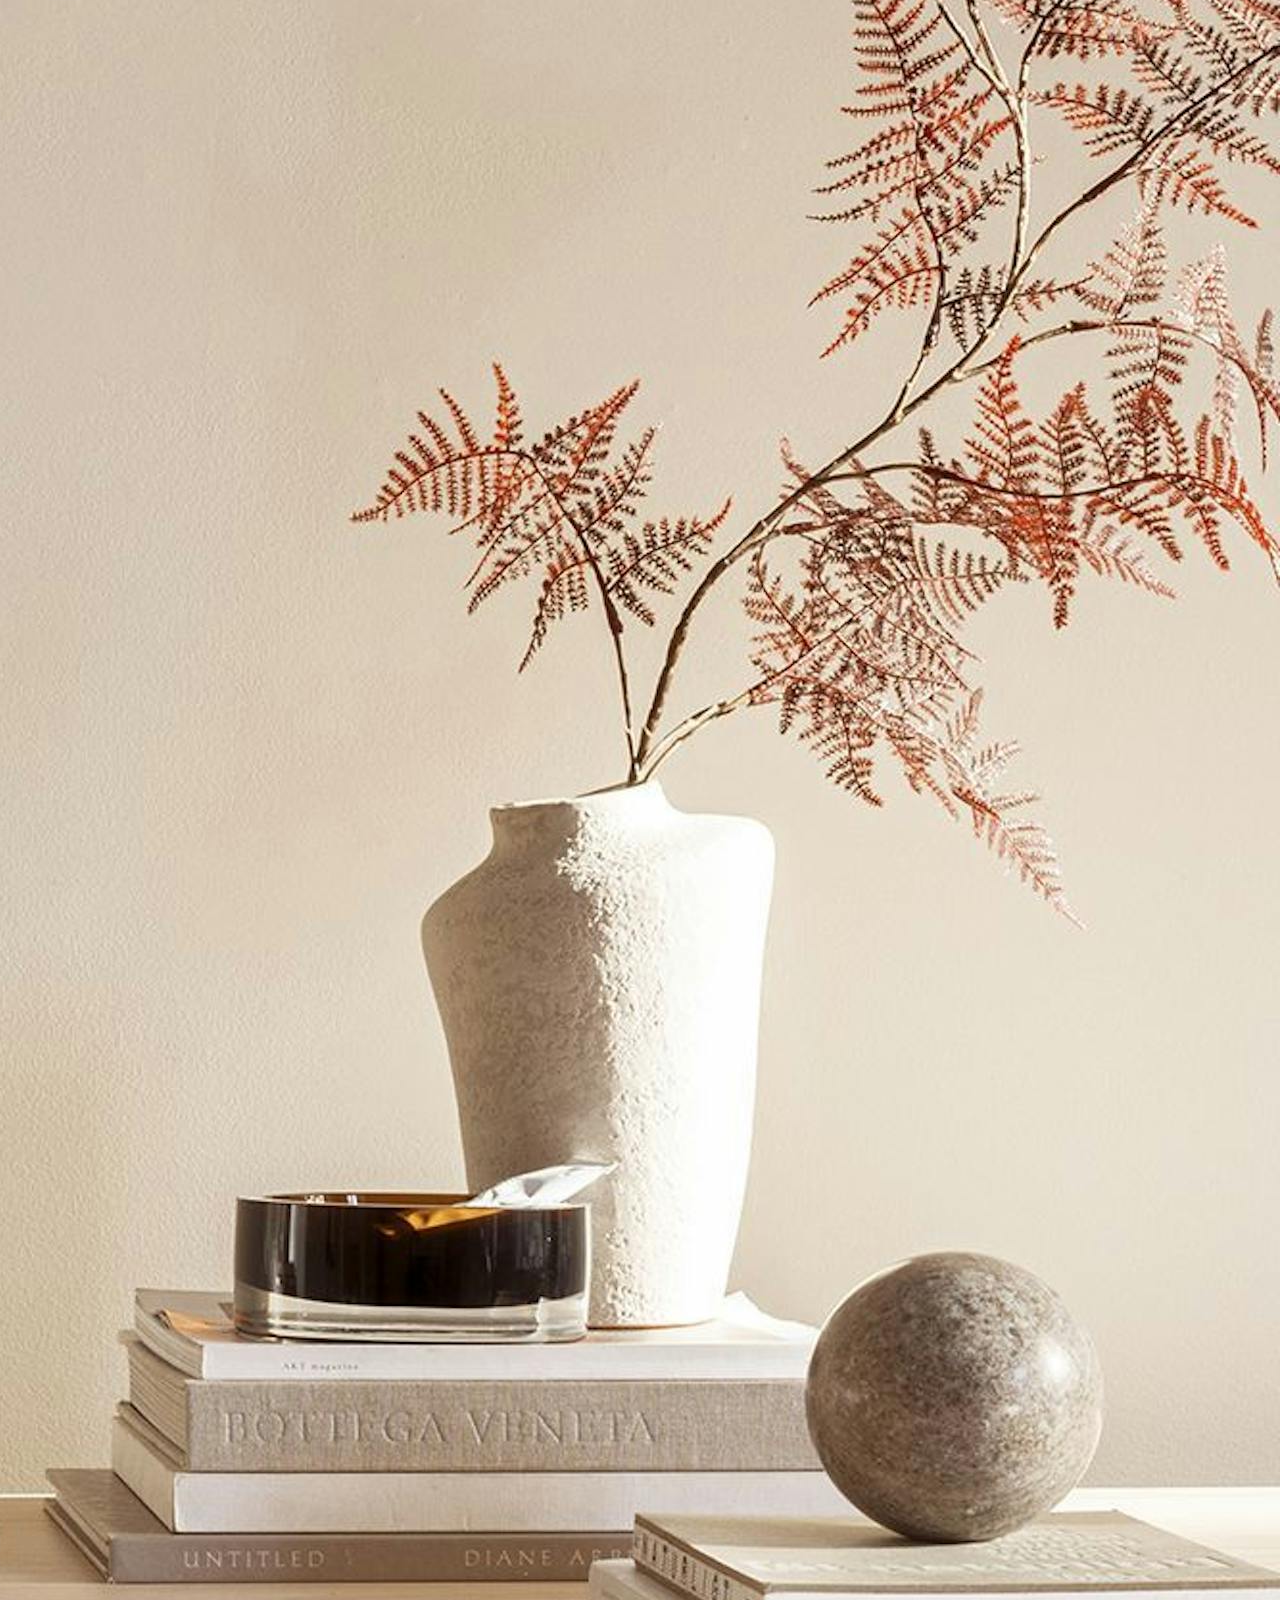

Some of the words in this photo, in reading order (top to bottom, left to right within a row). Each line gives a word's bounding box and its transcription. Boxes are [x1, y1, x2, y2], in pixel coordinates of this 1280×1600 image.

[222, 1409, 448, 1445] BOTTEGA
[464, 1409, 657, 1445] VENETA
[183, 1548, 326, 1569] UNTITLED
[464, 1548, 553, 1568] DIANE
